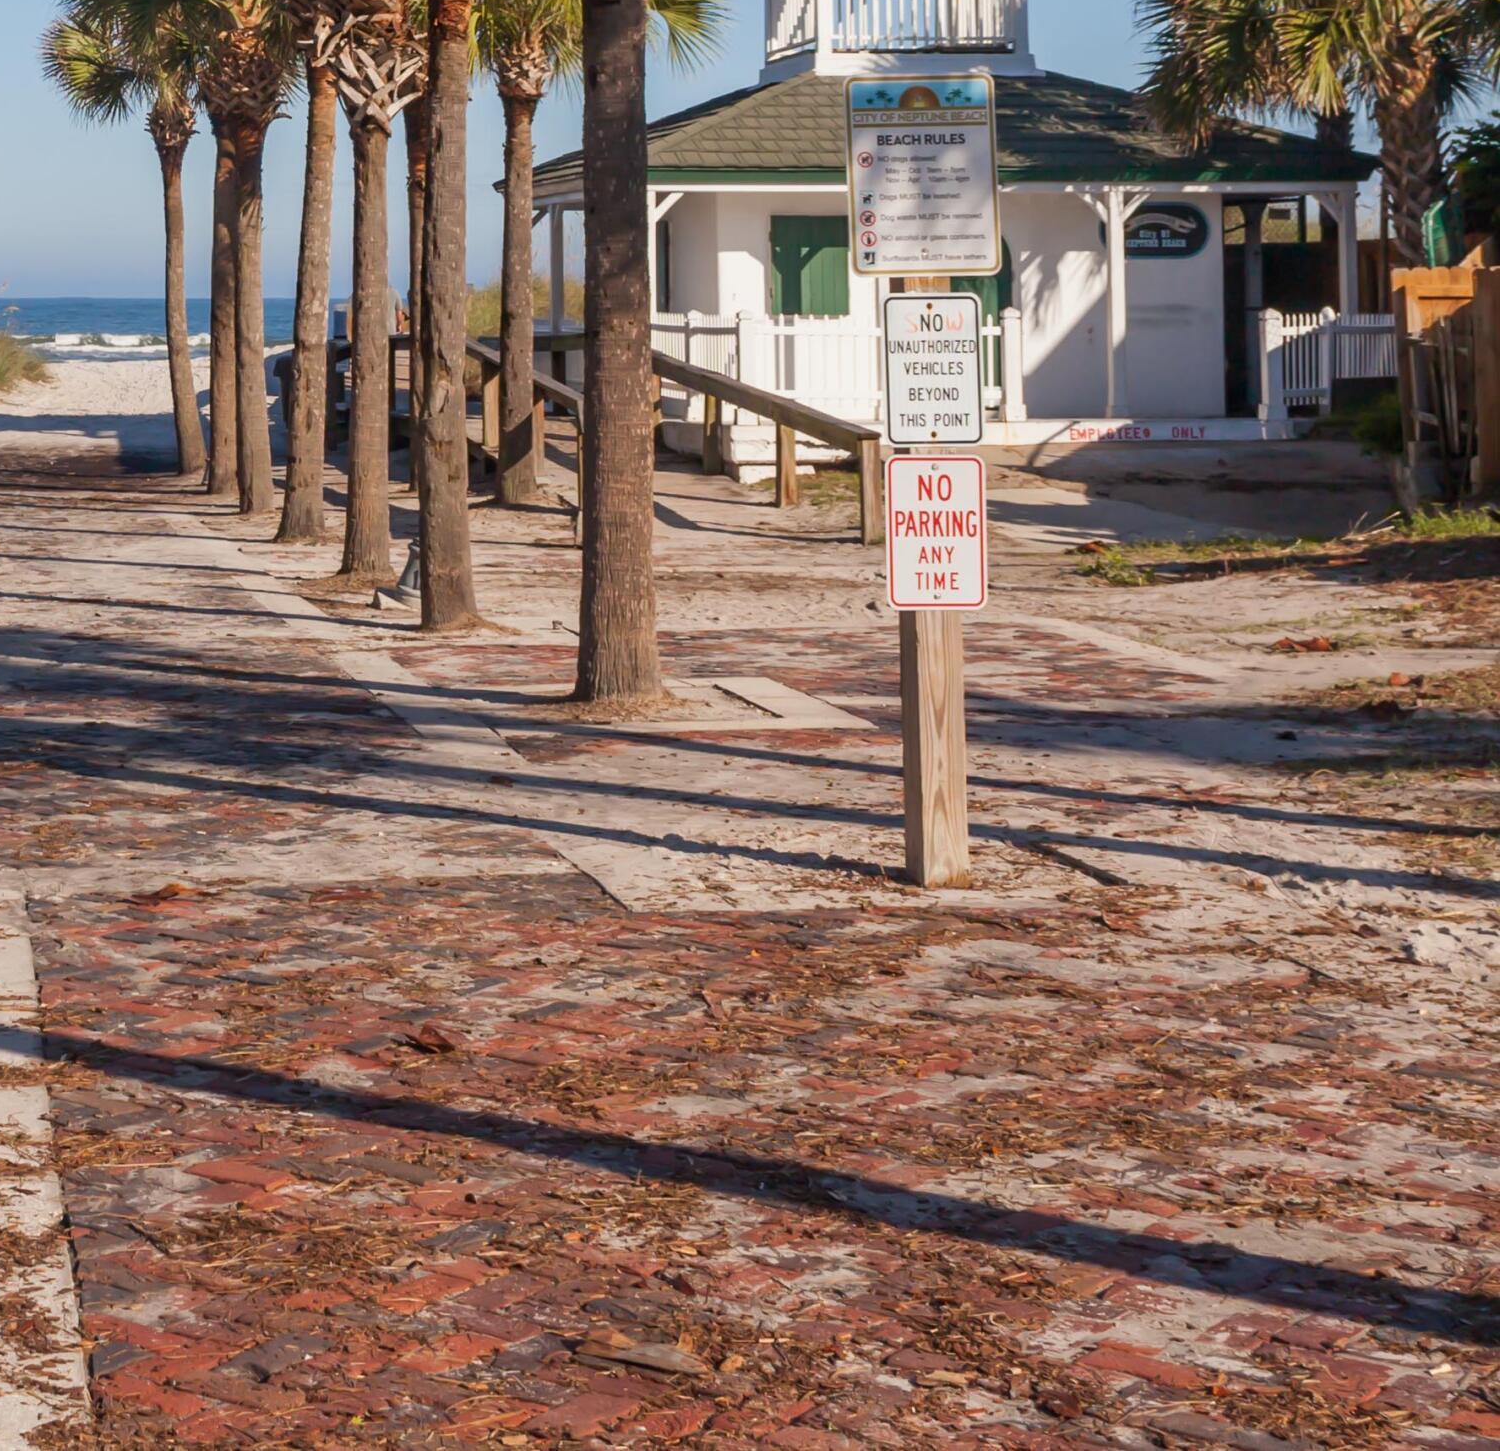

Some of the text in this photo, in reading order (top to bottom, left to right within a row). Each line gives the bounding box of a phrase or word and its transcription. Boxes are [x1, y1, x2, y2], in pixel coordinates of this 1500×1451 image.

[853, 111, 987, 123] CITY OF NEPTUNE BEACH
[877, 133, 966, 146] BEACH RULES
[880, 214, 895, 222] Dog
[920, 314, 943, 332] NO
[889, 340, 977, 354] UNAUTHORIZED
[904, 362, 964, 375] VEHICLES
[909, 387, 959, 401] BEYOND
[900, 413, 971, 427] THIS POINT
[1171, 426, 1205, 439] ONLY
[918, 474, 952, 501] NO
[895, 510, 977, 538] PARKING
[918, 546, 955, 564] ANY
[915, 572, 959, 590] TIME
